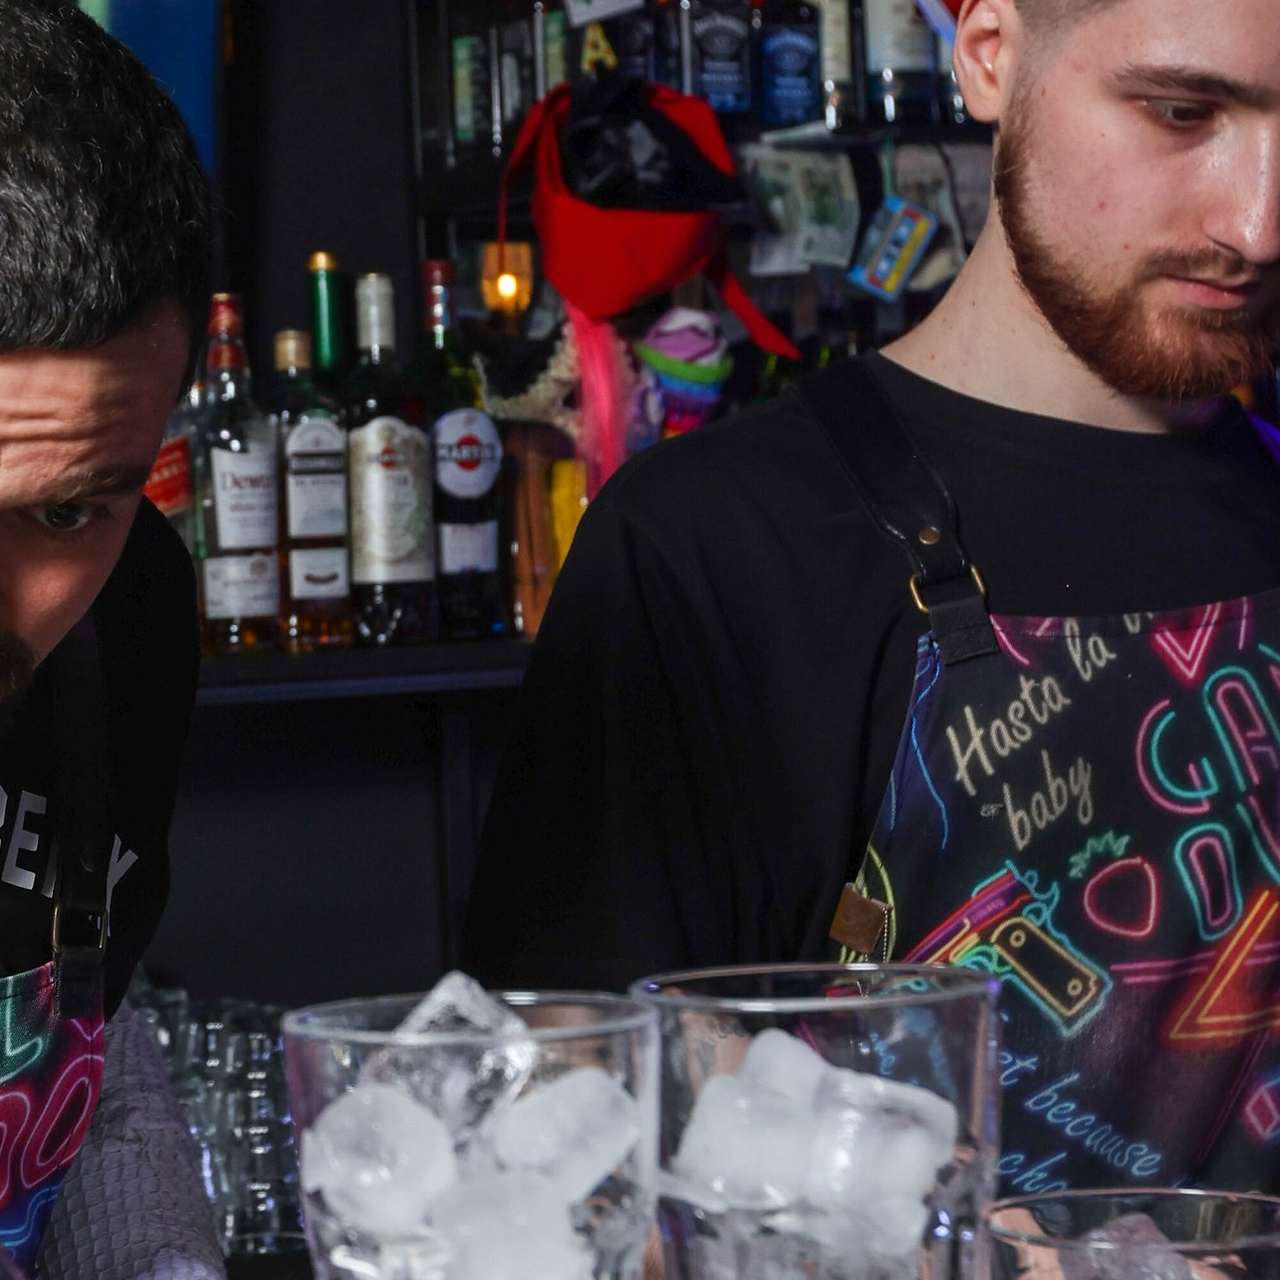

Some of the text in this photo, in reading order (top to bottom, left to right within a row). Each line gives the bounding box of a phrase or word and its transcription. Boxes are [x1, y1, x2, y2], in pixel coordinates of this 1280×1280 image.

[946, 674, 1073, 797] Hasta
[1003, 750, 1094, 852] baby
[1024, 1073, 1163, 1177] because
